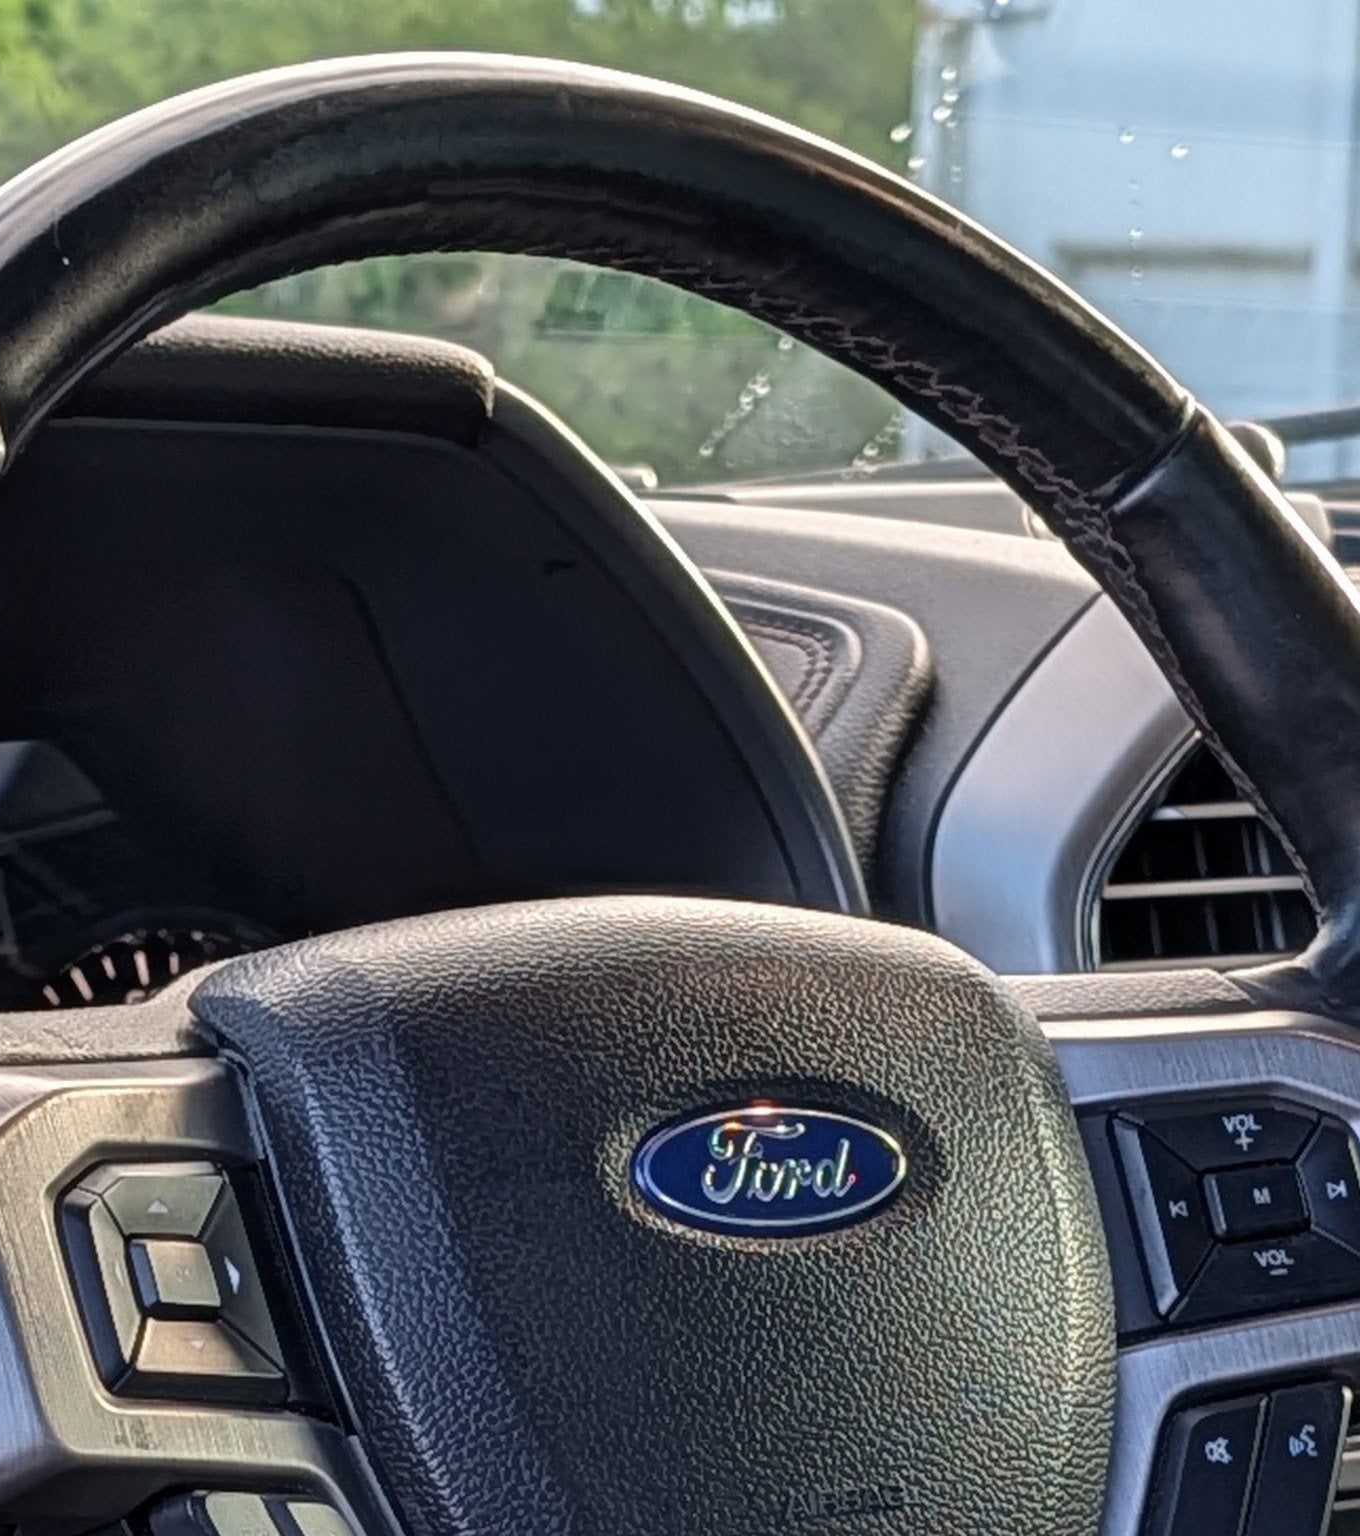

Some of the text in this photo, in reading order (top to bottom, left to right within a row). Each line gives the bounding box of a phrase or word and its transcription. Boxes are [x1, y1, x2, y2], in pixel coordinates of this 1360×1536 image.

[1222, 1114, 1262, 1134] VOL
[701, 1120, 857, 1205] Ford
[1252, 1187, 1272, 1206] M
[1253, 1249, 1294, 1269] VOL
